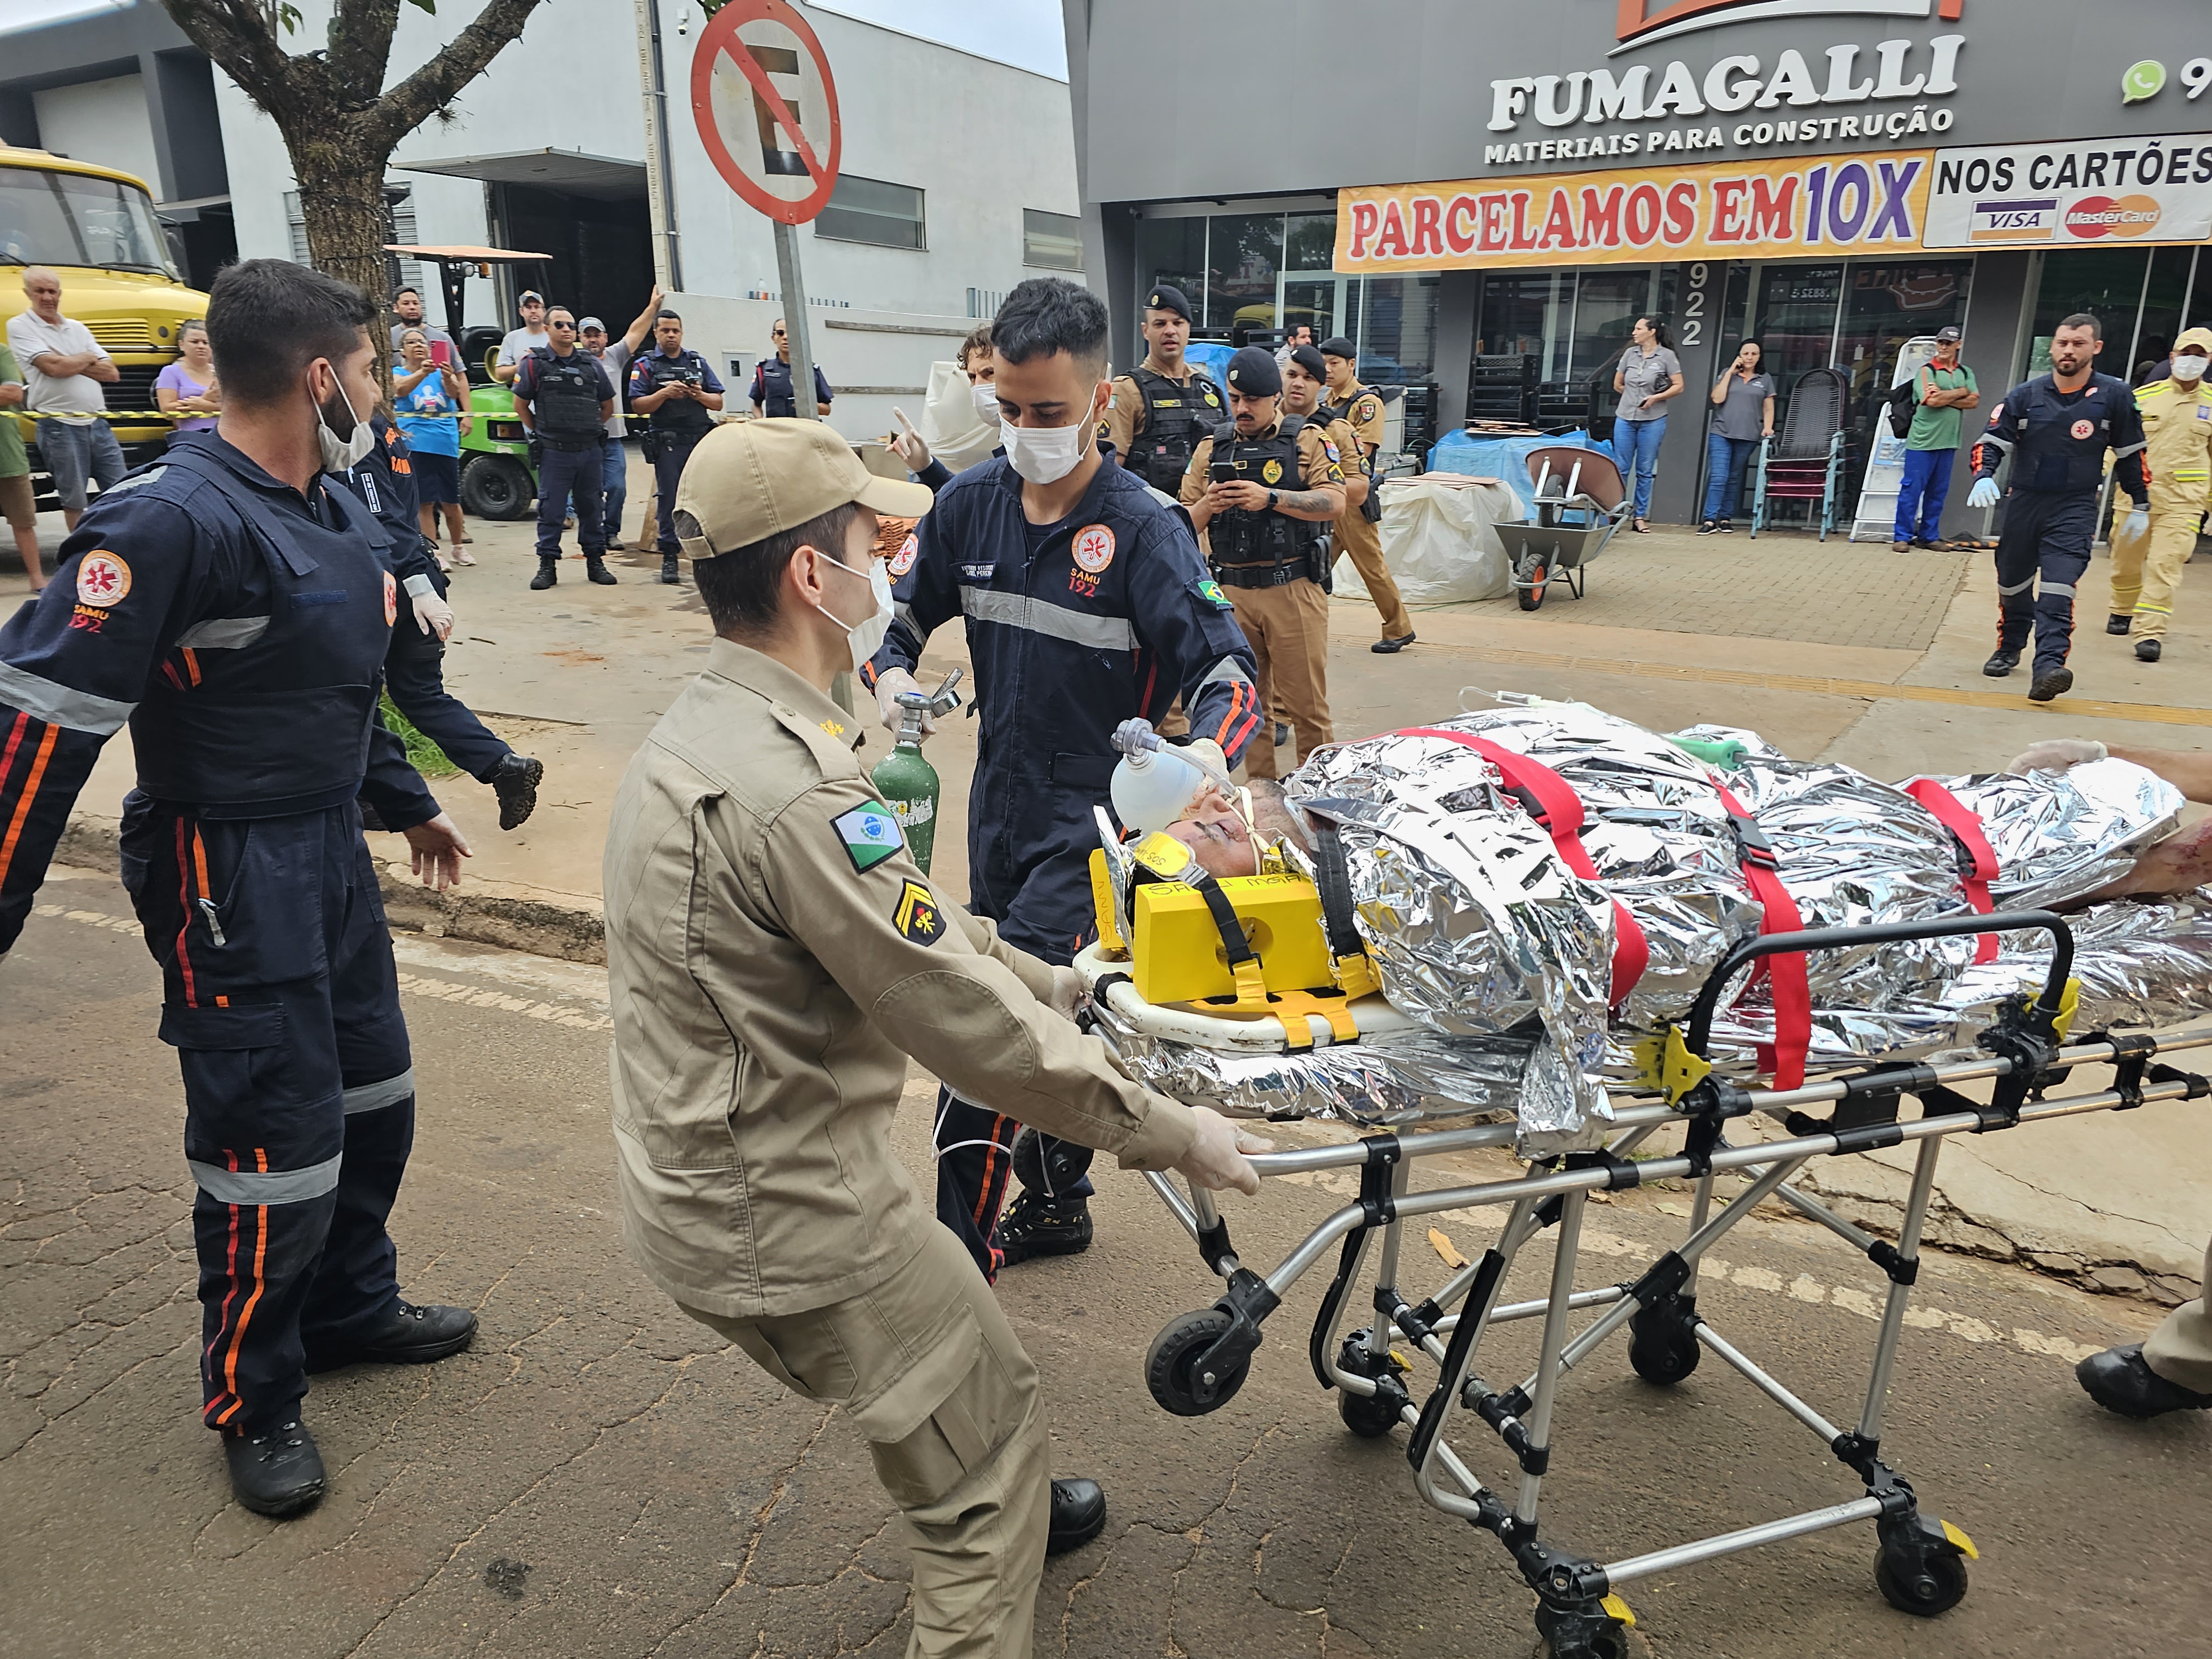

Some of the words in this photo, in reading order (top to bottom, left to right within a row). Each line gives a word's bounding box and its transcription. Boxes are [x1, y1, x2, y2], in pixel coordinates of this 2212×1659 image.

[1486, 34, 1965, 131] FUMAGALLI
[2180, 58, 2212, 99] 9
[745, 44, 810, 176] E
[1484, 133, 1640, 164] MATERIAIS
[1646, 127, 1724, 152] PARA
[1733, 105, 1954, 145] CONSTRUÇÃO
[1937, 157, 2015, 195] NOS
[2029, 140, 2212, 190] CARTÕES
[1349, 181, 1697, 259] PARCELAMOS
[1708, 176, 1798, 242] EM
[1806, 161, 1923, 242] 10X
[1988, 212, 2041, 228] VISA
[2065, 210, 2160, 225] MasterCard
[1070, 568, 1100, 585] SAMU
[1068, 577, 1096, 598] 192
[74, 604, 110, 620] SAMU
[68, 614, 103, 634] 192
[1148, 879, 1232, 895] SAU
[1246, 874, 1301, 887] MGA
